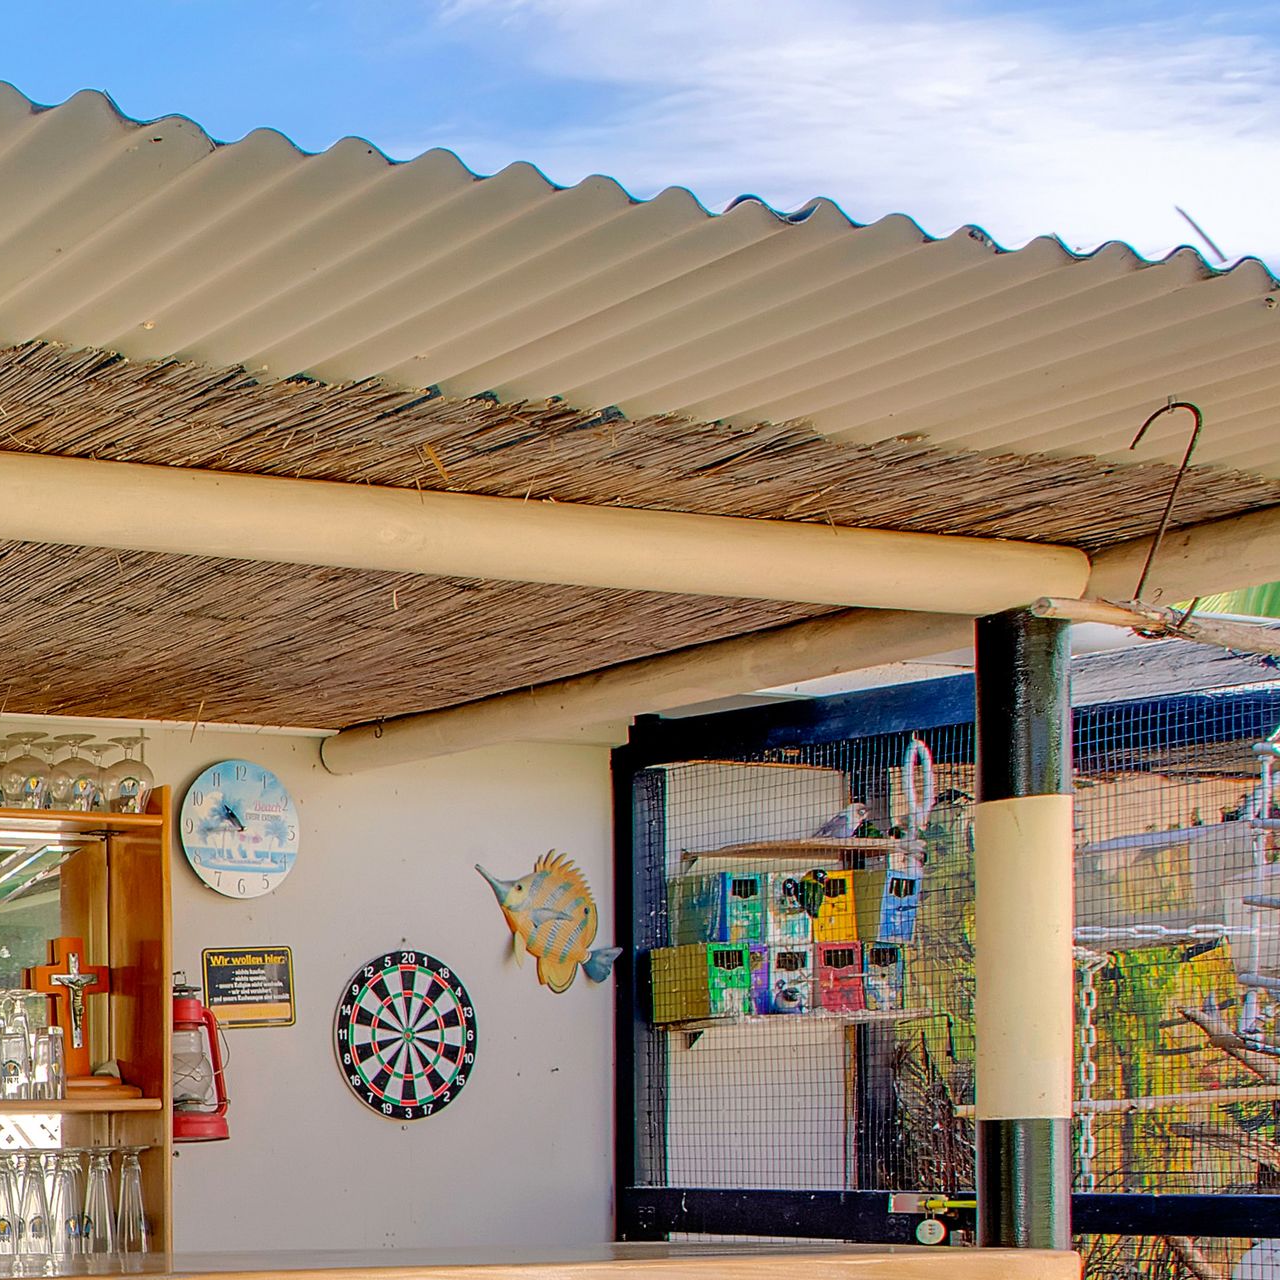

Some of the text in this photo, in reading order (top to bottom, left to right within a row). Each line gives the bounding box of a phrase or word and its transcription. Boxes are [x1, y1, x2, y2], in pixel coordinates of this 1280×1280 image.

[236, 765, 247, 782] 12
[212, 772, 221, 788] 11
[192, 791, 204, 806] 10
[280, 796, 289, 812] 2
[185, 818, 194, 834] 9
[287, 824, 296, 841] 3
[193, 848, 202, 864] 8
[280, 854, 288, 872] 4
[214, 870, 222, 888] 7
[262, 874, 270, 890] 5
[237, 878, 246, 894] 6
[384, 956, 392, 967] 5
[401, 952, 416, 964] 20
[422, 957, 428, 966] 1
[363, 967, 374, 978] 12
[439, 968, 450, 978] 18
[352, 984, 359, 995] 9
[456, 987, 462, 997] 4
[341, 1005, 351, 1016] 14
[463, 1007, 473, 1017] 13
[338, 1030, 348, 1040] 11
[466, 1030, 474, 1040] 6
[344, 1053, 351, 1064] 8
[464, 1053, 474, 1064] 10
[350, 1076, 361, 1086] 16
[456, 1075, 465, 1086] 15
[367, 1093, 374, 1103] 7
[443, 1091, 450, 1102] 2
[382, 1103, 393, 1114] 19
[405, 1108, 412, 1119] 3
[422, 1104, 433, 1115] 17
